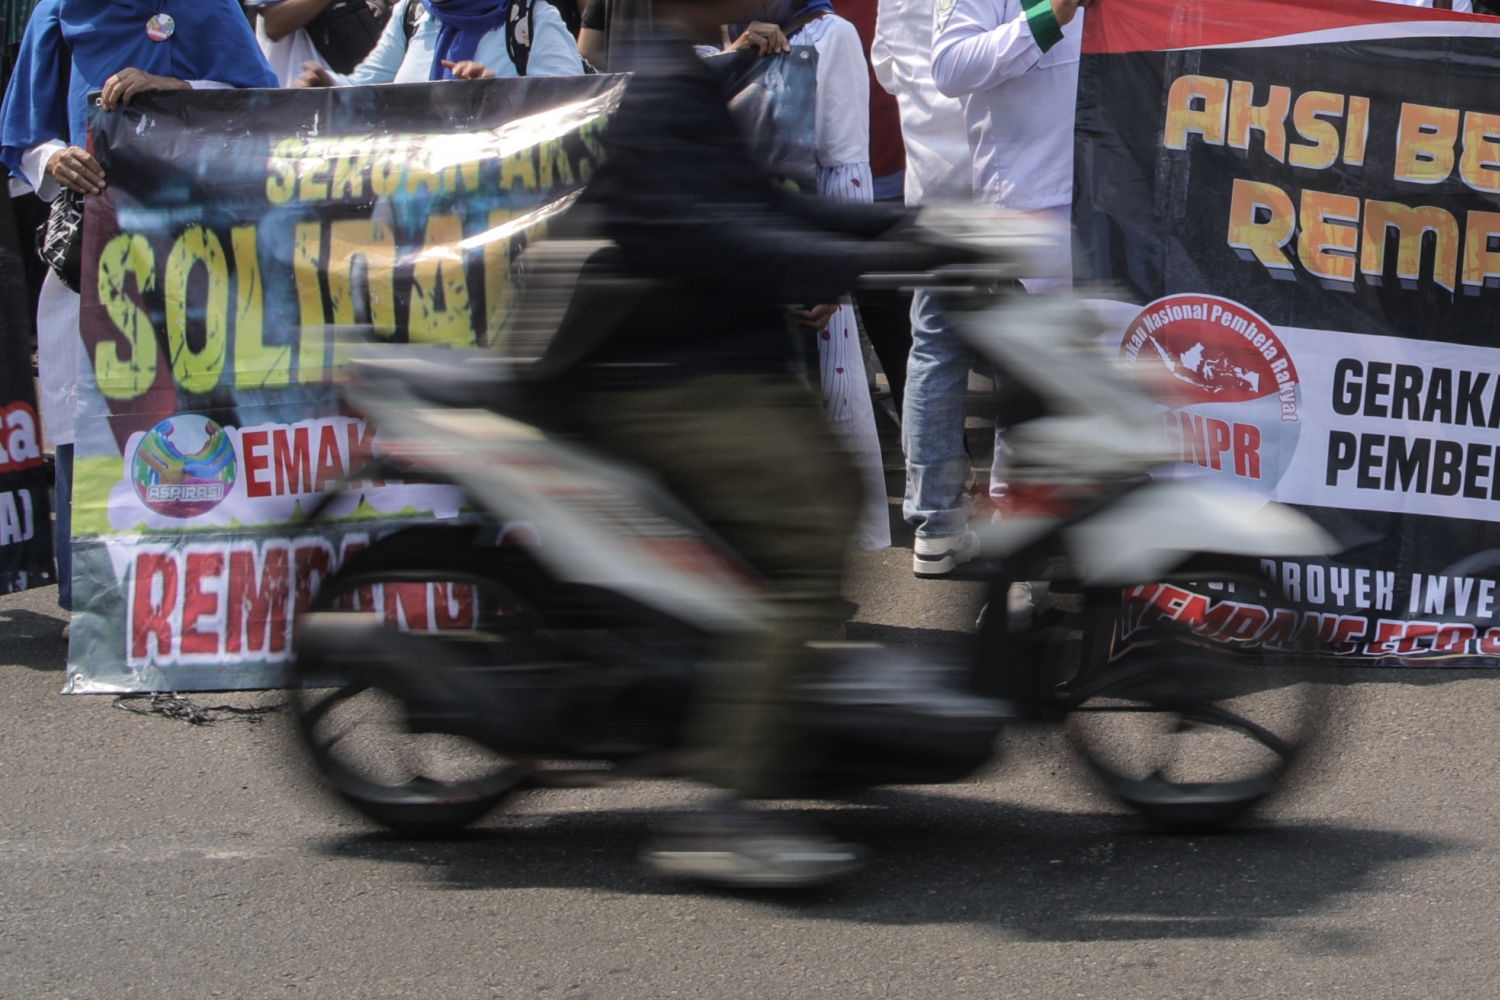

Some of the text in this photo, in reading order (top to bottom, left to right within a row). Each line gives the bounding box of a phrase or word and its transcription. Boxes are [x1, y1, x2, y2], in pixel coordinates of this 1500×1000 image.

[1163, 74, 1371, 172] AKSI
[1124, 303, 1299, 423] akan Nasional Pembela Rakyat
[149, 485, 223, 500] ASPIRASI
